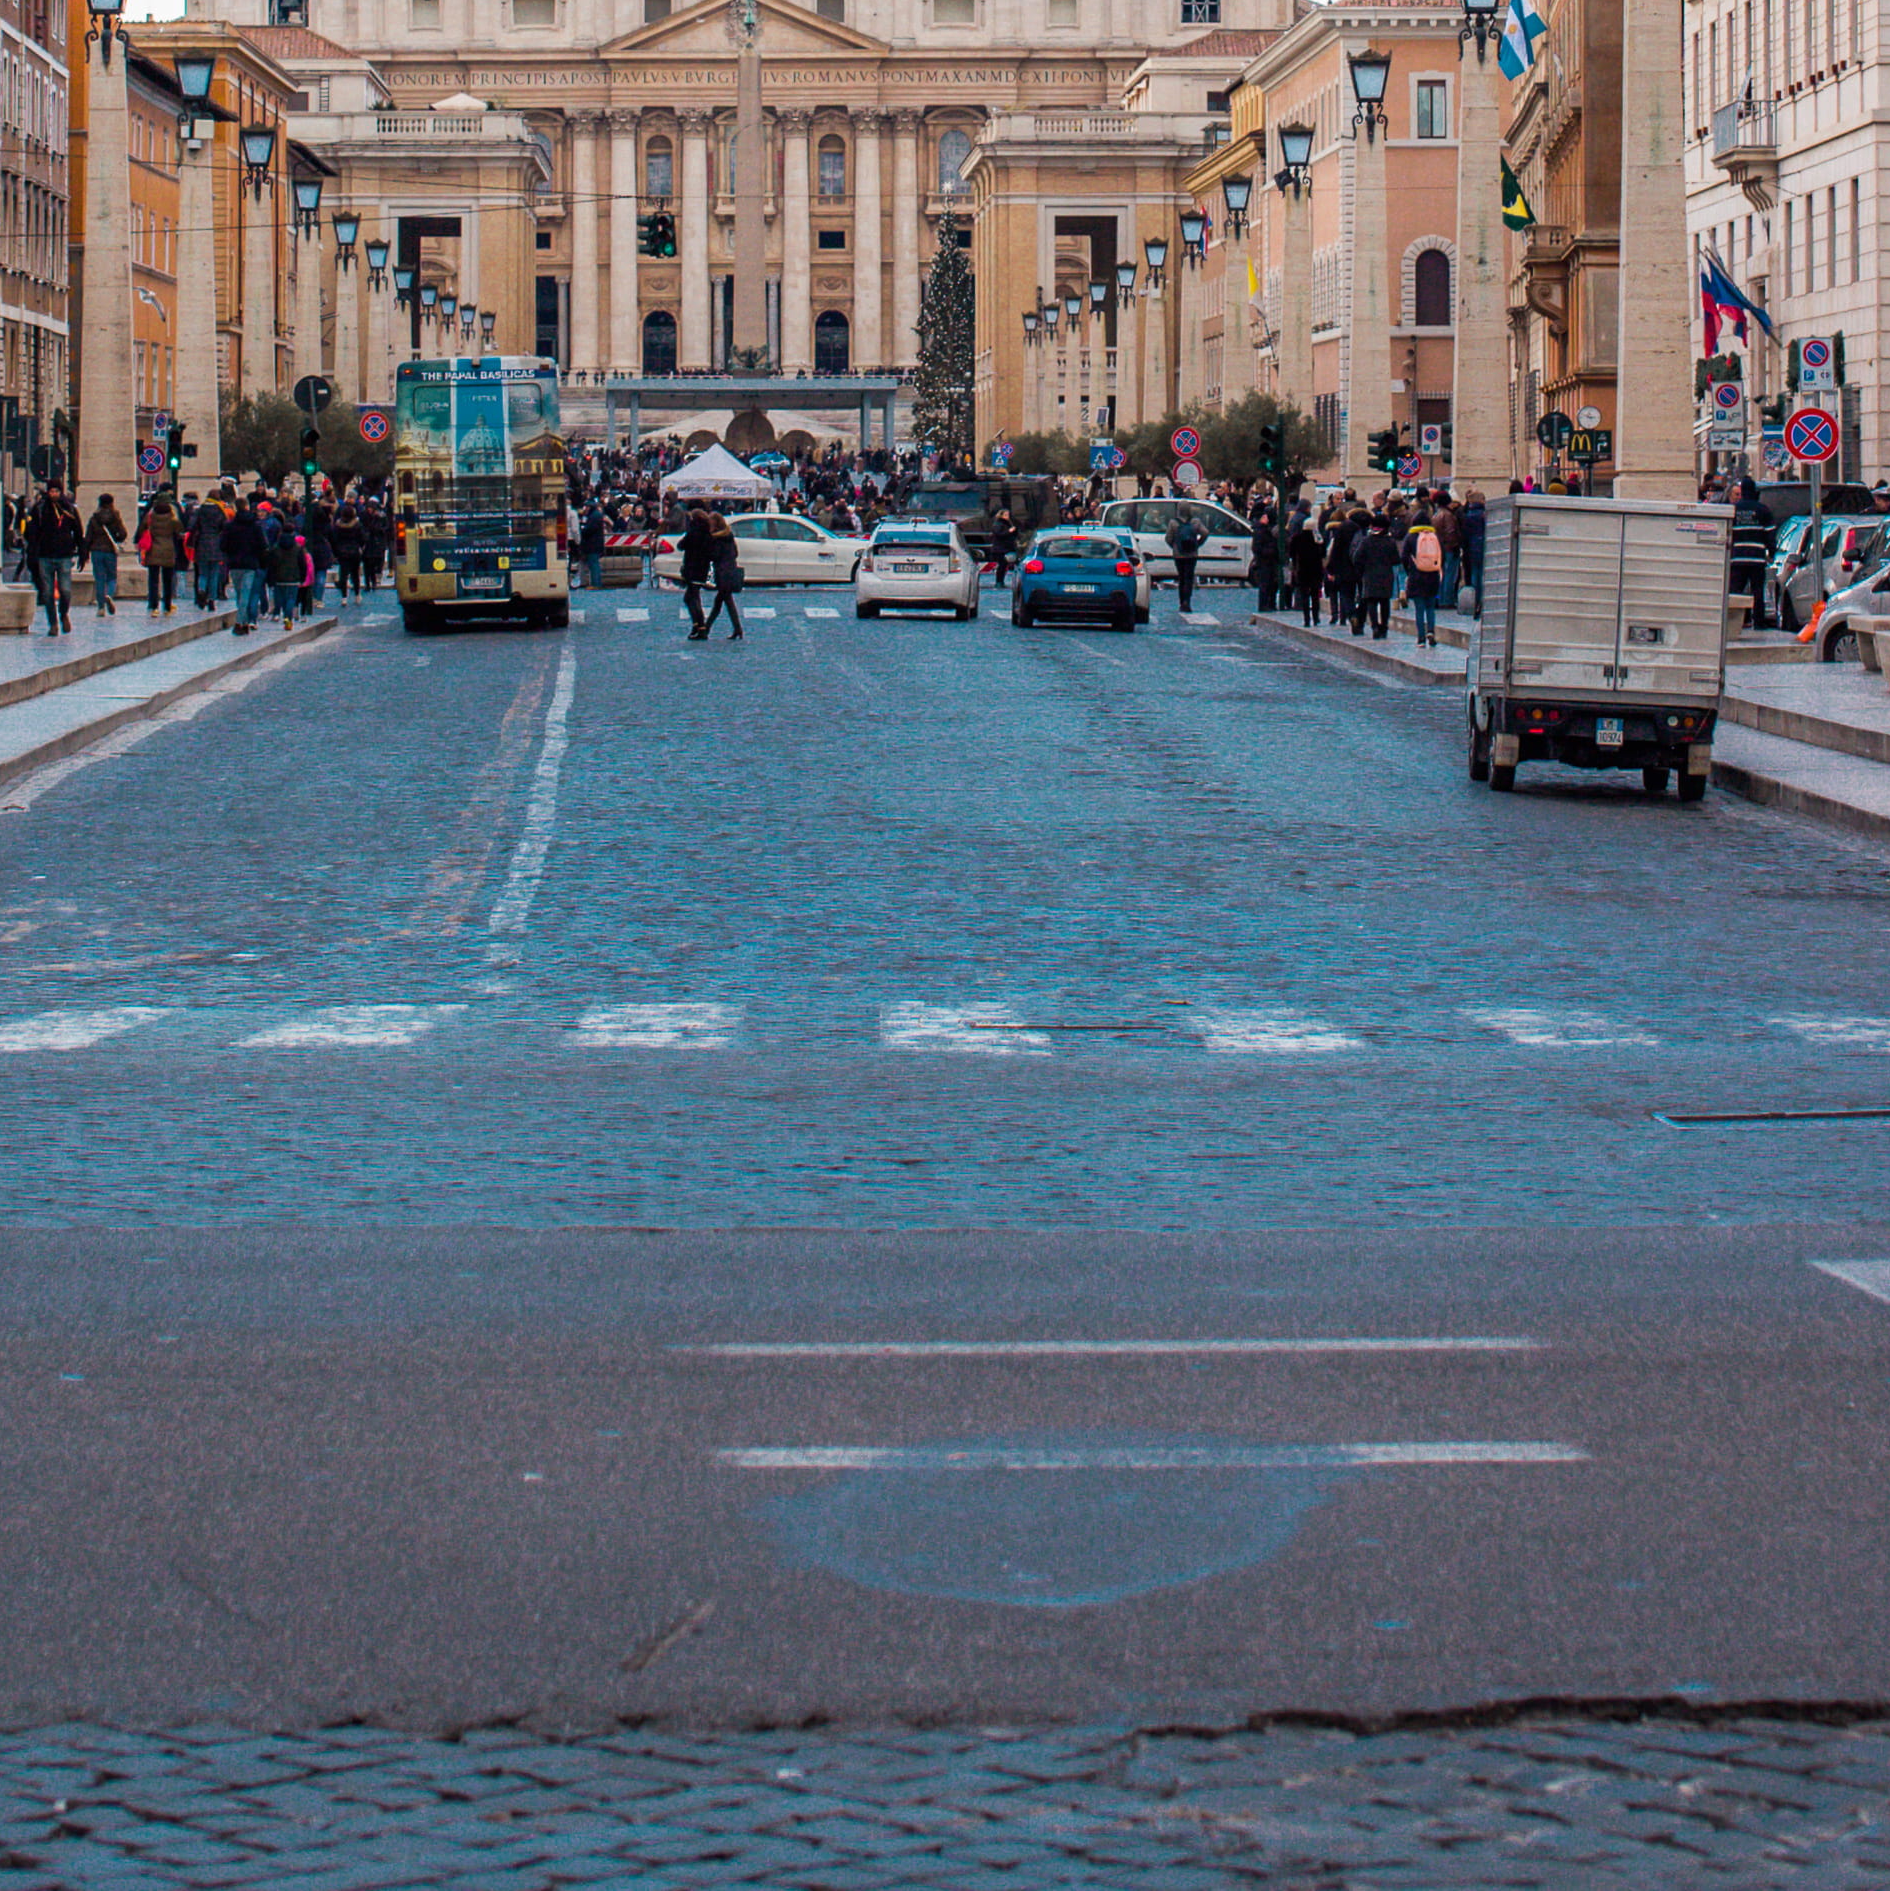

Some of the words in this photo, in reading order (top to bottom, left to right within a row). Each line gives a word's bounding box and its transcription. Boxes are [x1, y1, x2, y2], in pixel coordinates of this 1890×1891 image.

[383, 72, 467, 86] HONOREM
[471, 72, 556, 86] PRINCIPIS
[558, 71, 609, 85] APOST
[613, 71, 669, 85] PAVLVS
[793, 70, 877, 83] ROMANVS
[1060, 70, 1103, 83] PONT
[421, 372, 443, 381] THE
[445, 371, 477, 380] PAPAL
[480, 369, 536, 380] BASILICAS
